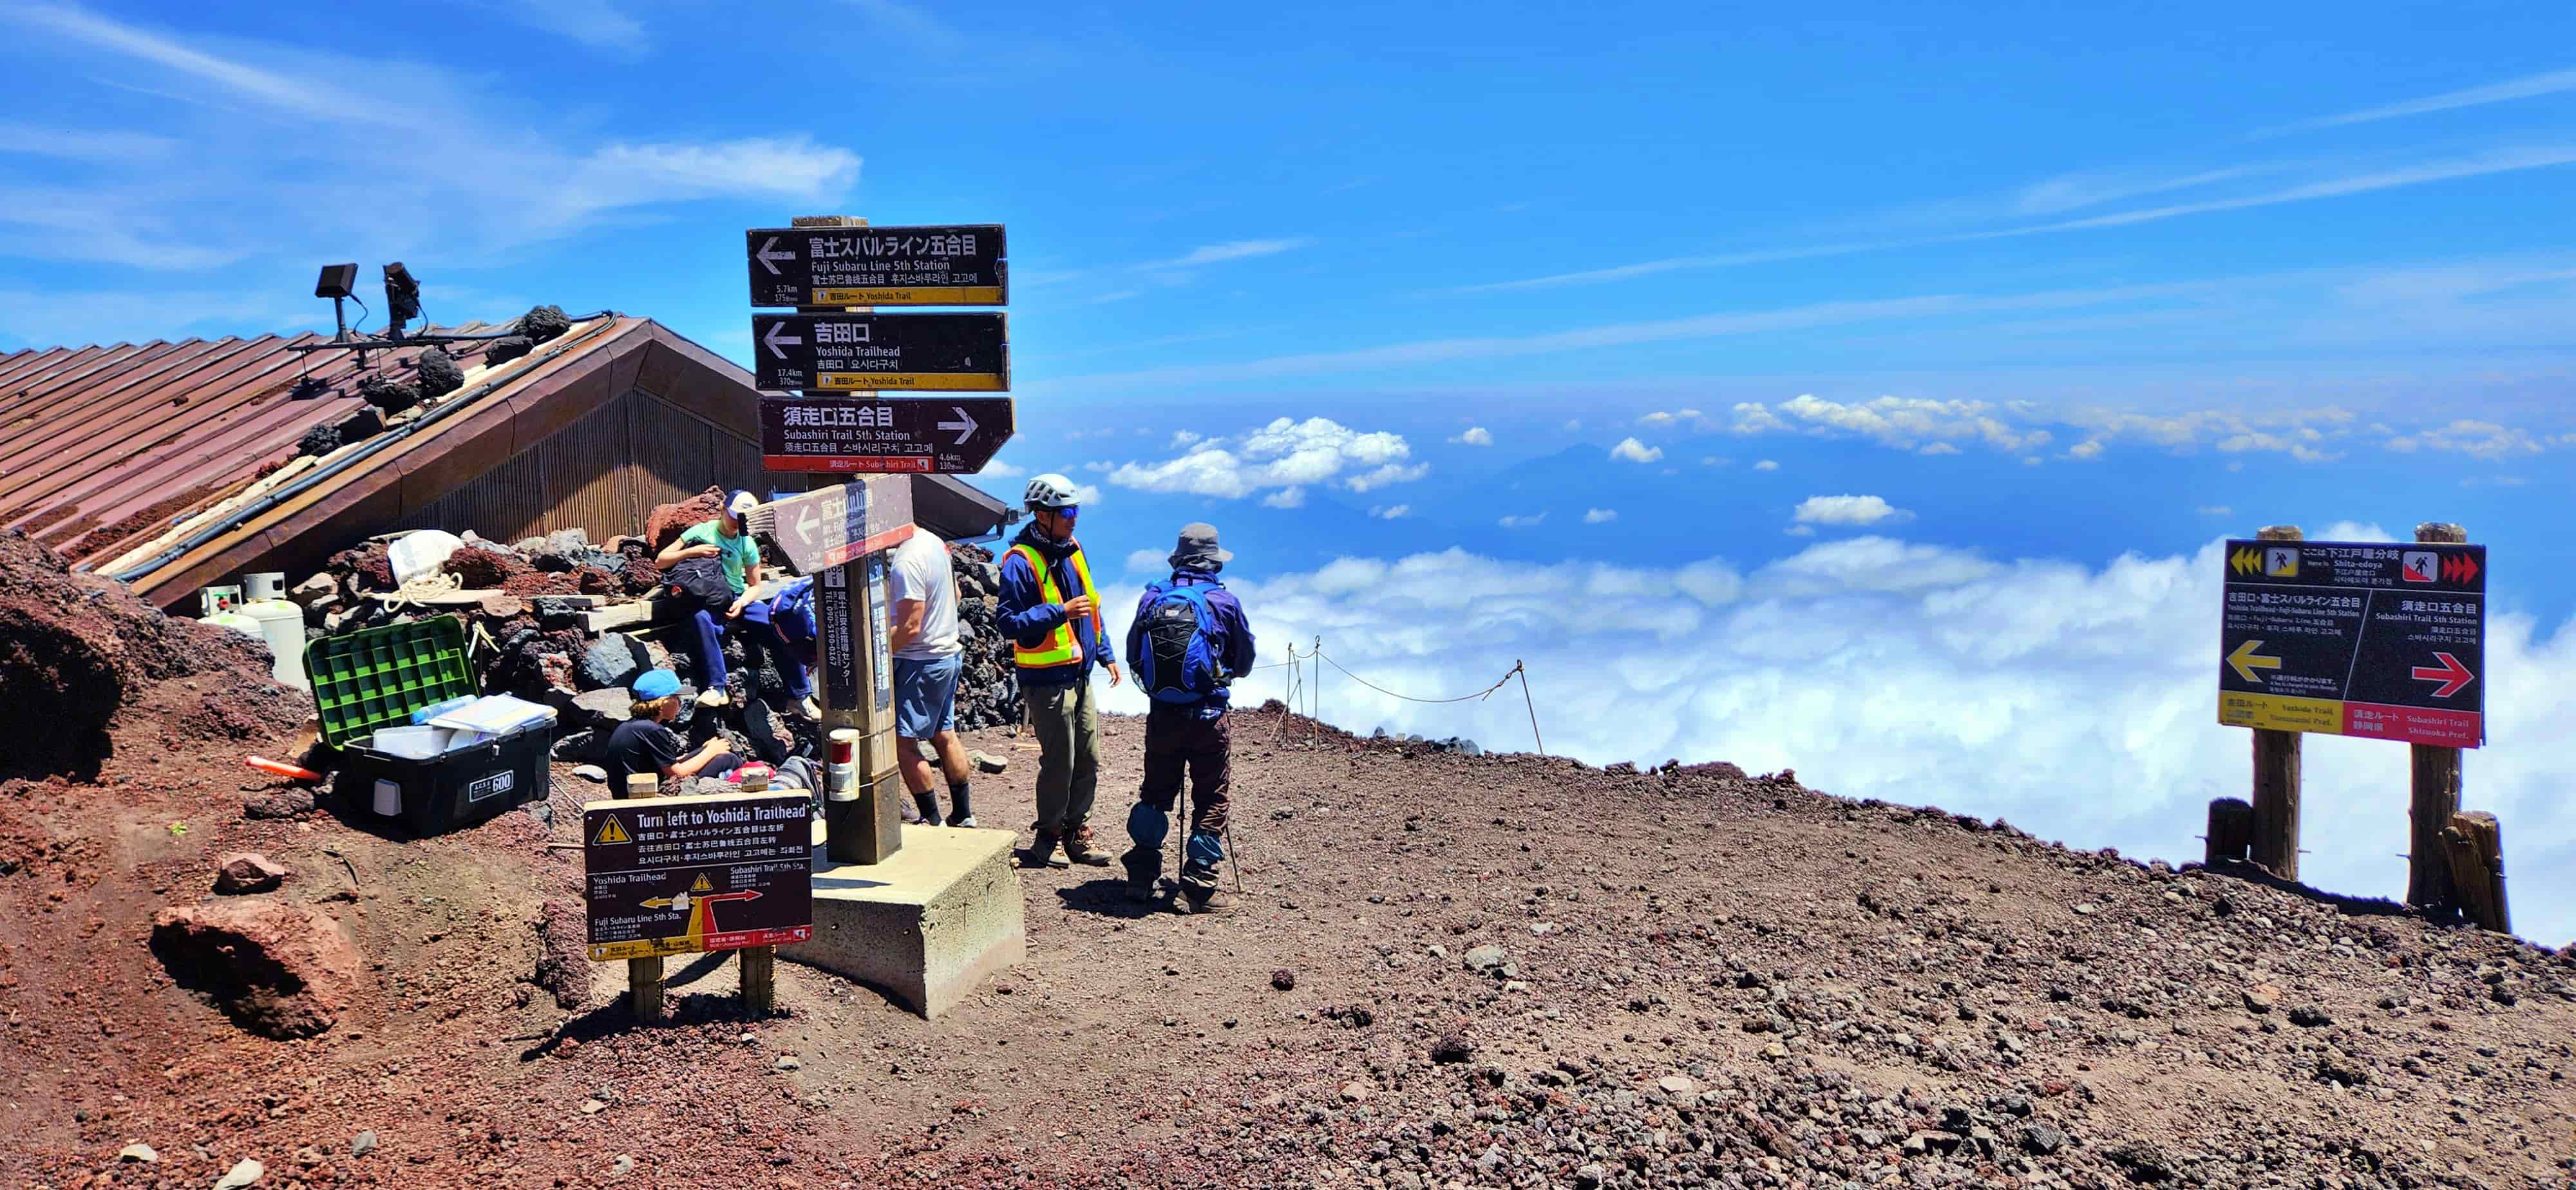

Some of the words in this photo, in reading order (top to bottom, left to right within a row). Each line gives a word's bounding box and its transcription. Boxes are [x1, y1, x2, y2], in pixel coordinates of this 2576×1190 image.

[809, 234, 976, 258] 富士スバルライン五合目
[812, 261, 829, 273] Fuji
[833, 261, 867, 271] Subaru
[870, 260, 891, 271] Line
[894, 260, 911, 270] 5th
[914, 260, 950, 270] Station
[777, 285, 797, 293] 5.7km
[814, 322, 869, 343] 吉田口
[816, 346, 853, 356] Yoshida
[855, 346, 900, 356] Trailhead
[817, 359, 844, 370] 吉田口
[850, 359, 898, 370] 요시다구치
[777, 368, 802, 377] 17.4km
[783, 406, 893, 426] 須走口五合目
[784, 430, 829, 440] Subashiri
[831, 430, 853, 440] Trail
[856, 430, 872, 440] 5th
[875, 430, 910, 440] Station
[866, 460, 899, 468] Subhiri
[901, 460, 916, 468] Trail
[2334, 560, 2382, 569] Shita-edoya
[2401, 600, 2476, 614] 須走口五合目
[2376, 612, 2411, 621] Subashiri
[2414, 614, 2431, 623] Trail
[2448, 616, 2477, 625] Station
[826, 606, 837, 666] 090-5190-0167
[2406, 715, 2447, 726] Subashiri
[2448, 718, 2469, 727] Trail
[2408, 727, 2447, 737] Shizuoka
[493, 774, 511, 791] 600
[636, 814, 663, 828] Turn
[667, 811, 688, 827] left
[692, 811, 704, 824] to
[706, 807, 751, 824] Yoshida
[753, 803, 806, 820] Trailhead
[730, 865, 762, 874] Subashiri
[593, 876, 626, 885] Yoshida
[628, 872, 667, 882] Trailhead
[594, 918, 608, 927] Fuji
[610, 916, 636, 925] Subaru
[637, 914, 652, 923] Line
